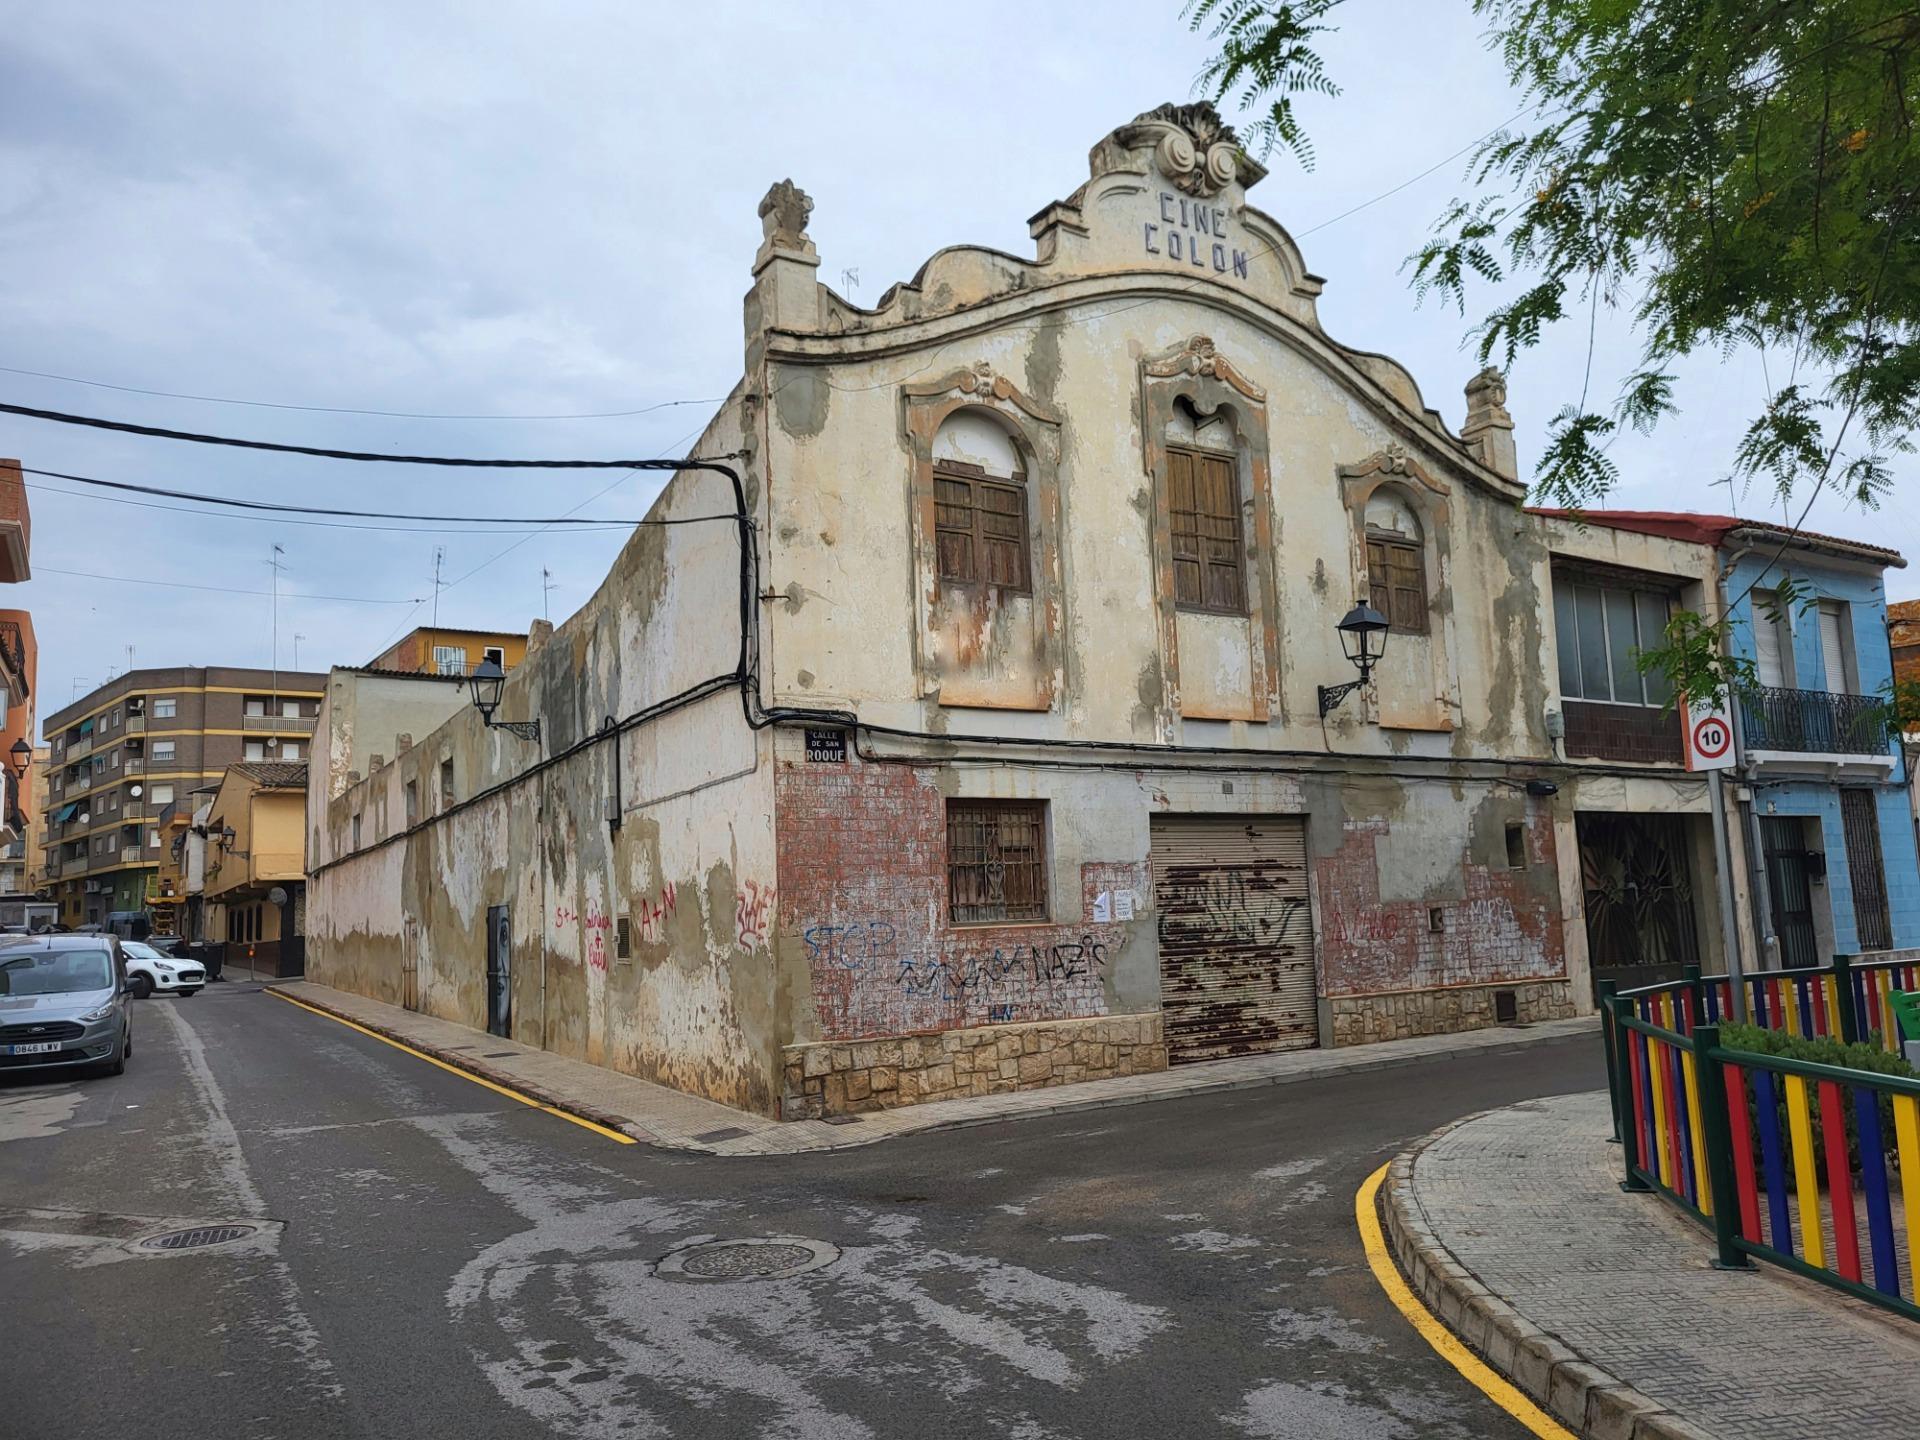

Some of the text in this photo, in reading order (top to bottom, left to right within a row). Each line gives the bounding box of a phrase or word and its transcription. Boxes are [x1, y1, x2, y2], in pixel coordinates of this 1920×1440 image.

[1160, 192, 1227, 239] CINE
[1145, 222, 1248, 280] COLON
[812, 731, 838, 739] CALLE
[1702, 730, 1721, 746] 10
[805, 922, 896, 971] STOP
